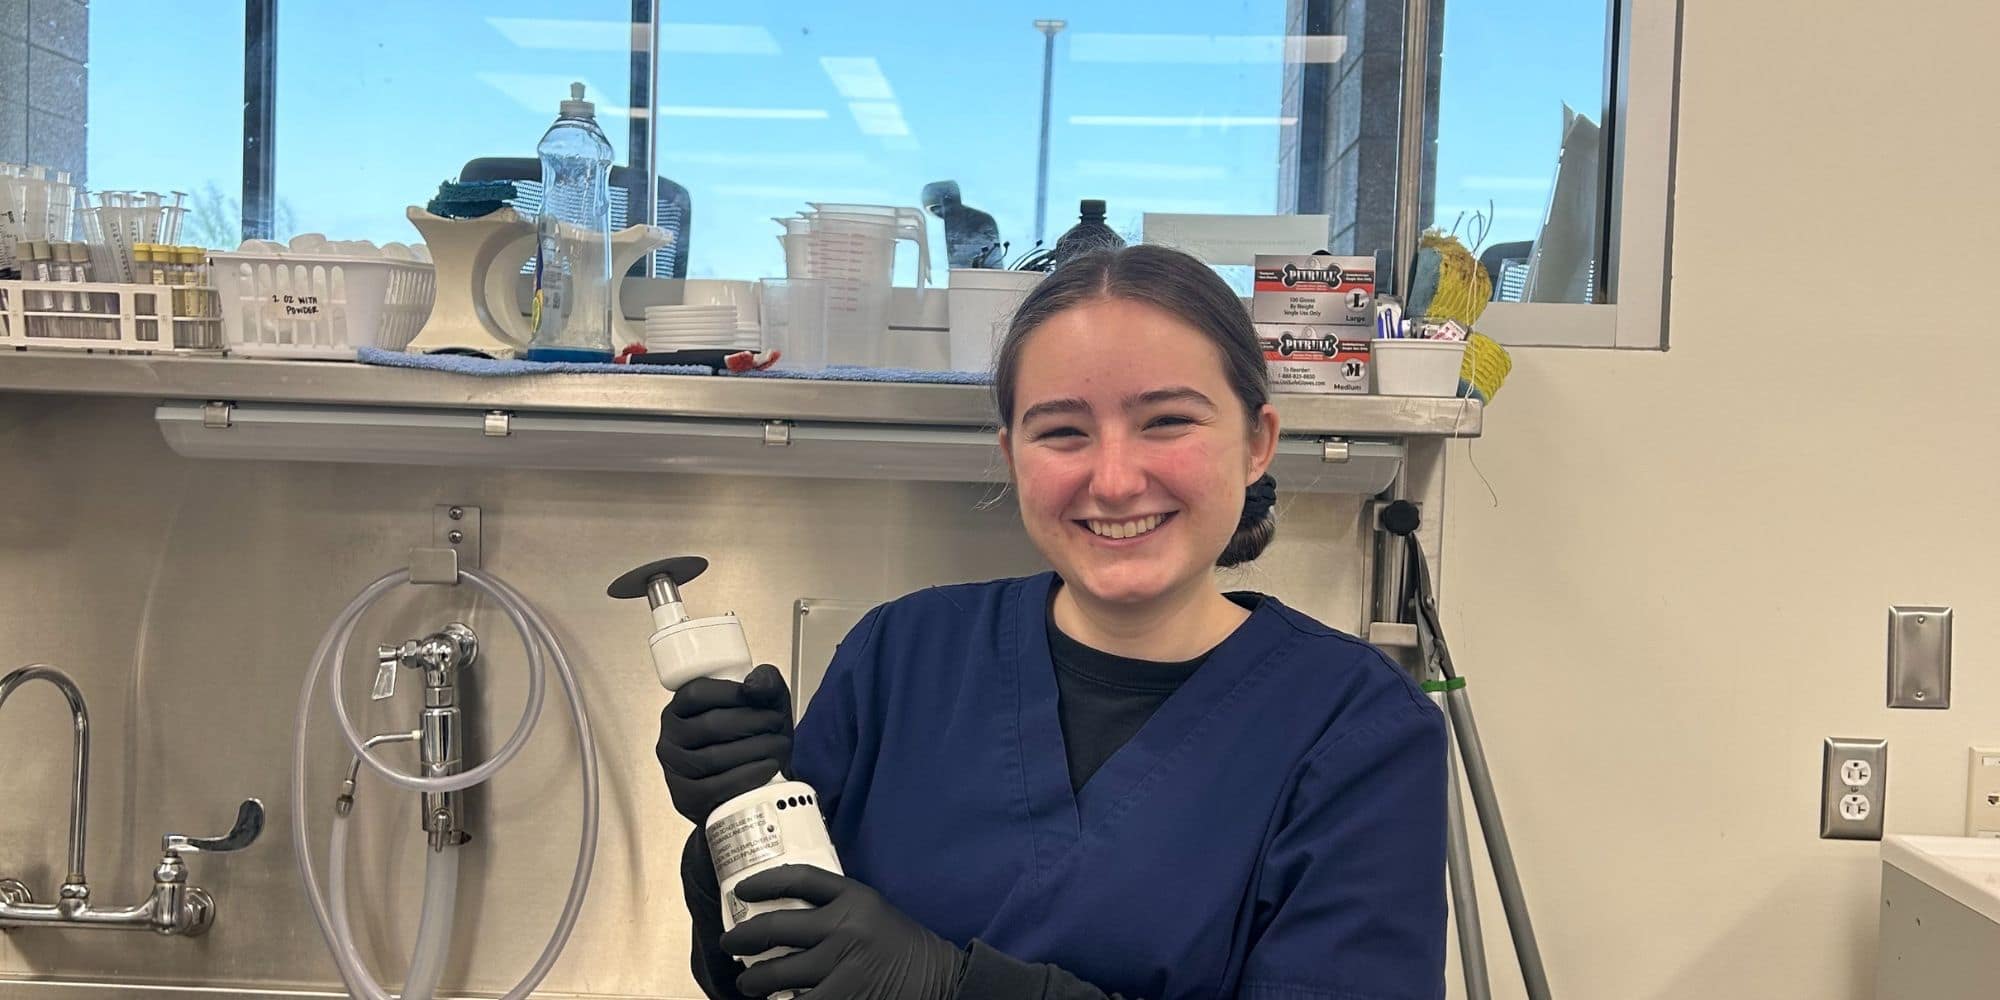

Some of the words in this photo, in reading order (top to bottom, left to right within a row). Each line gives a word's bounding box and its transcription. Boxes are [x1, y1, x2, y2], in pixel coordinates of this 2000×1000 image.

[1290, 270, 1336, 282] PITBULL
[272, 294, 280, 302] 2
[284, 295, 294, 303] OZ
[298, 296, 318, 304] WITH
[1354, 293, 1364, 308] L
[286, 306, 319, 315] POWDER
[1346, 315, 1365, 323] Large
[1286, 339, 1332, 352] PITBULL
[1346, 363, 1360, 376] M
